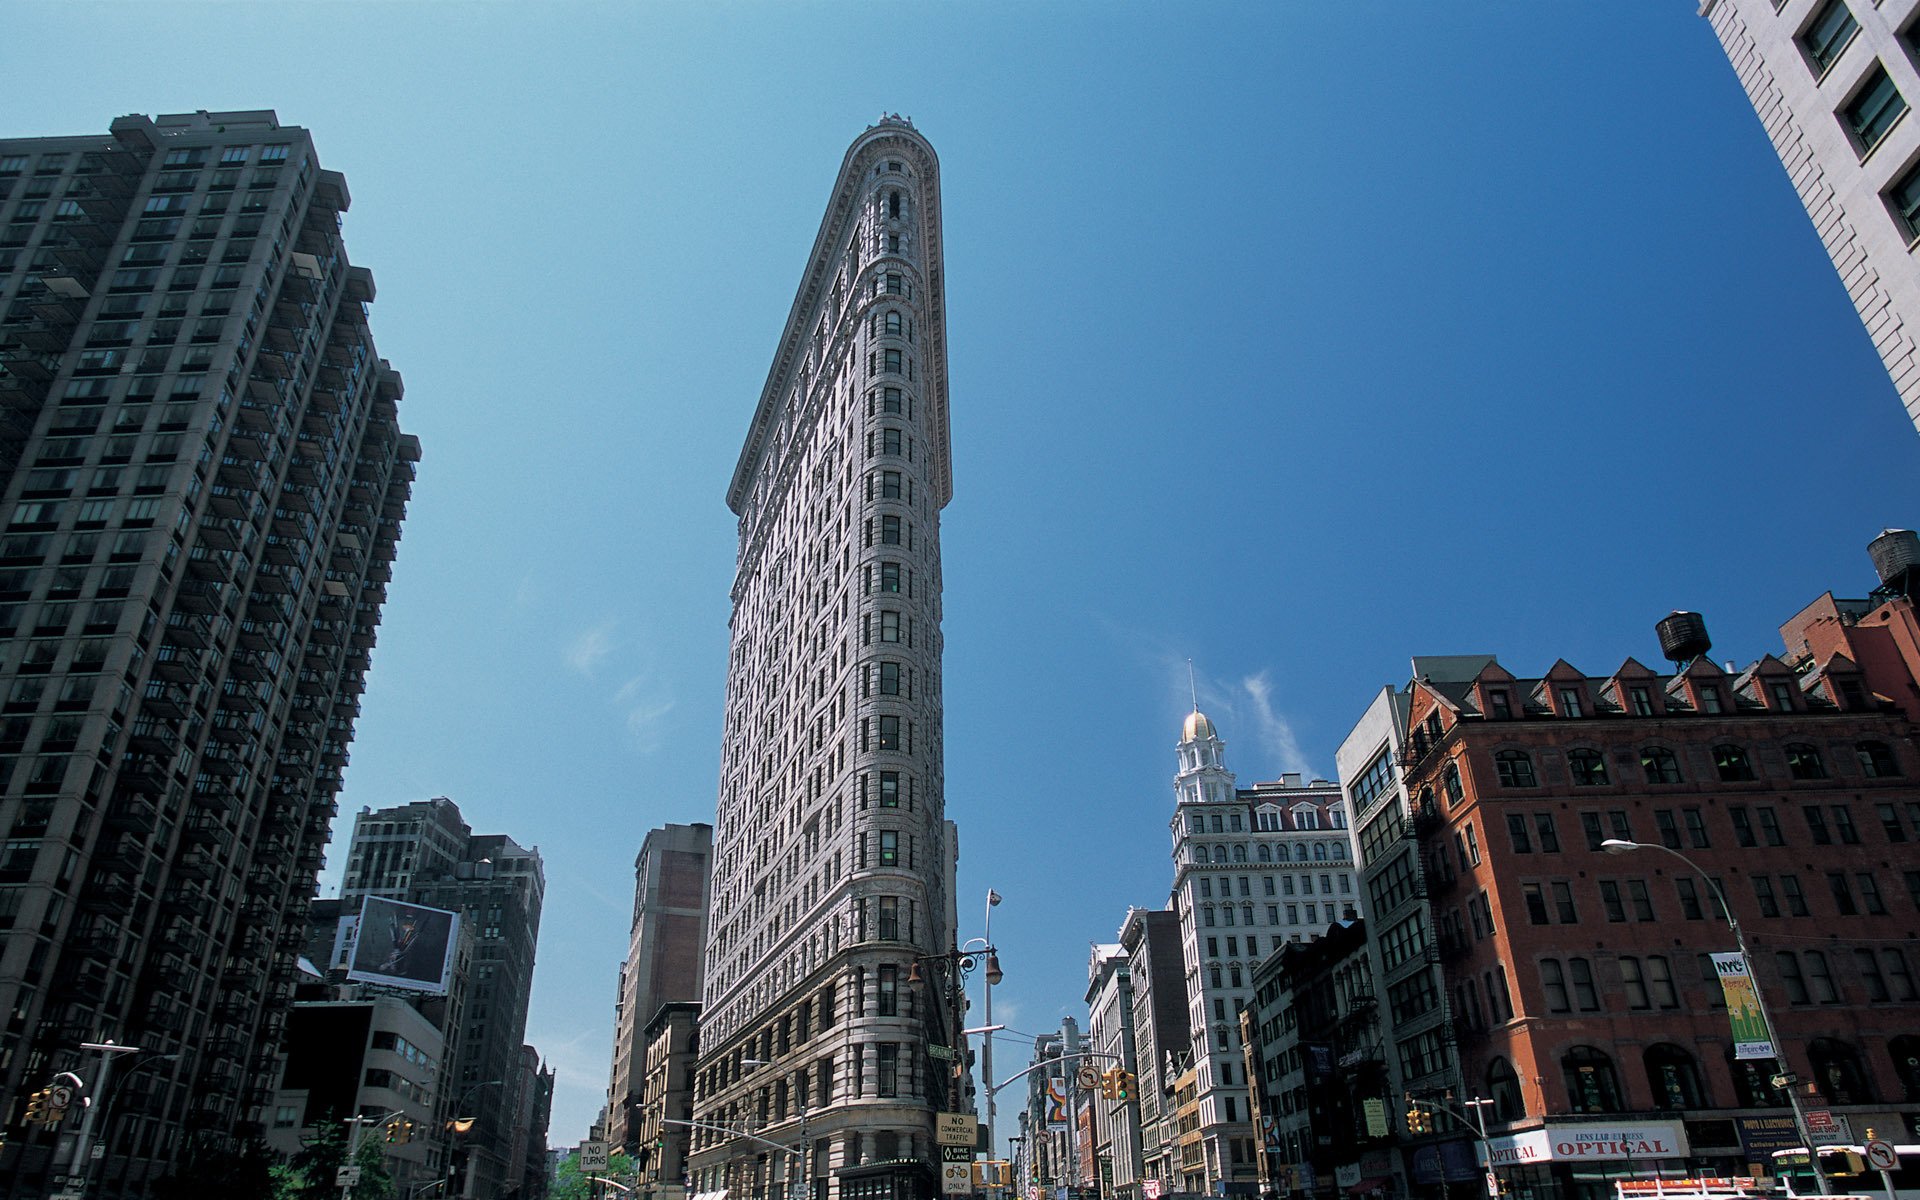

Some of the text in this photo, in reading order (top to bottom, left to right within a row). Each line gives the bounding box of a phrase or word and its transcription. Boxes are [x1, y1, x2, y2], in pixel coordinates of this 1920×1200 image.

[1716, 959, 1743, 972] NYC
[930, 1045, 953, 1059] BROADWAY
[951, 1117, 964, 1125] NO
[940, 1125, 974, 1134] COMMERCIAL
[946, 1133, 968, 1142] TRAFFIC
[1576, 1133, 1593, 1141] LENS
[588, 1145, 601, 1154] NO
[1557, 1140, 1669, 1156] OPTICAL
[1490, 1145, 1537, 1163] OPTICAL
[582, 1156, 606, 1165] TURNS
[948, 1182, 965, 1190] ONLY
